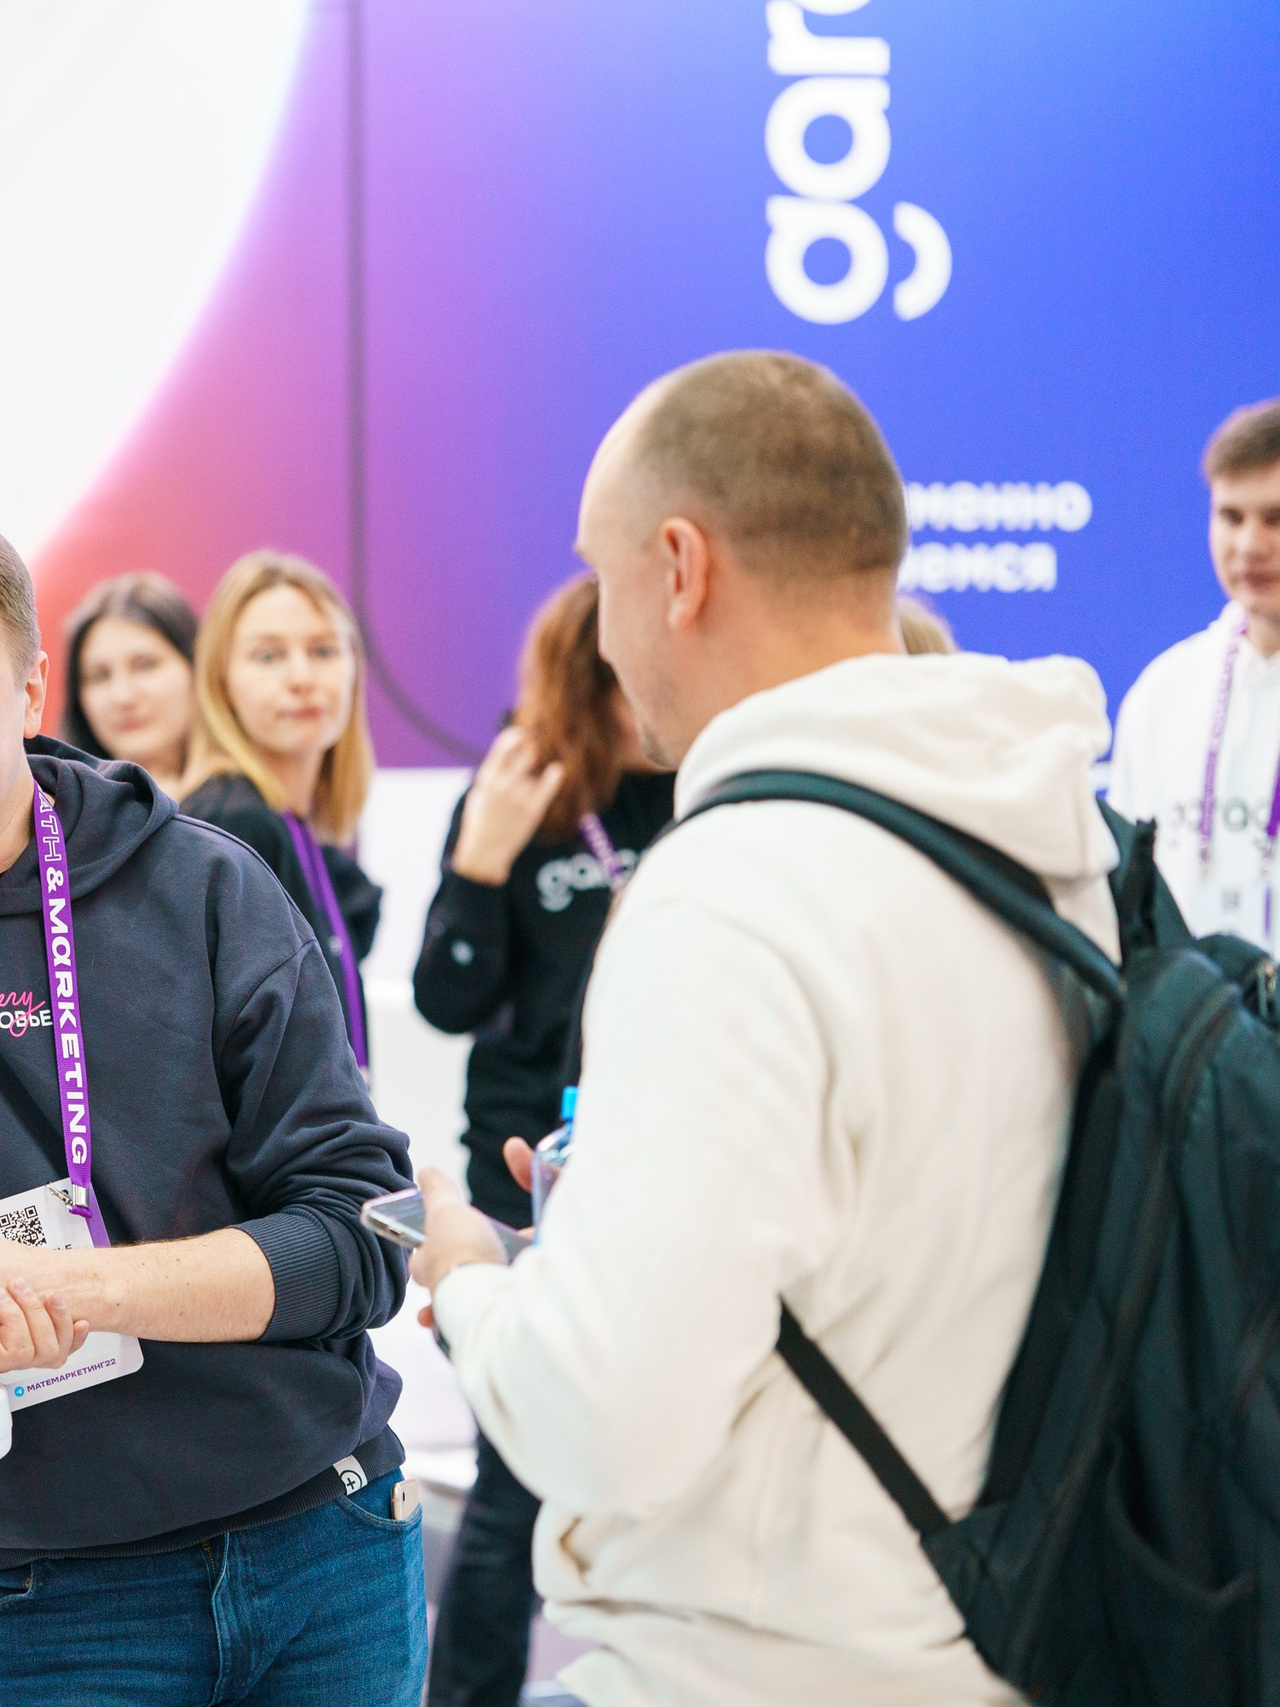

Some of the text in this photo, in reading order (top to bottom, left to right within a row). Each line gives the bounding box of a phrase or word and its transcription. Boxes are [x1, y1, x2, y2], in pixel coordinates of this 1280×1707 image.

[764, 0, 953, 325] gar
[906, 480, 1093, 532] менно
[37, 783, 62, 862] ATH
[46, 867, 64, 893] &
[26, 1357, 118, 1393] МАТЕМАРКЕТИНГ22
